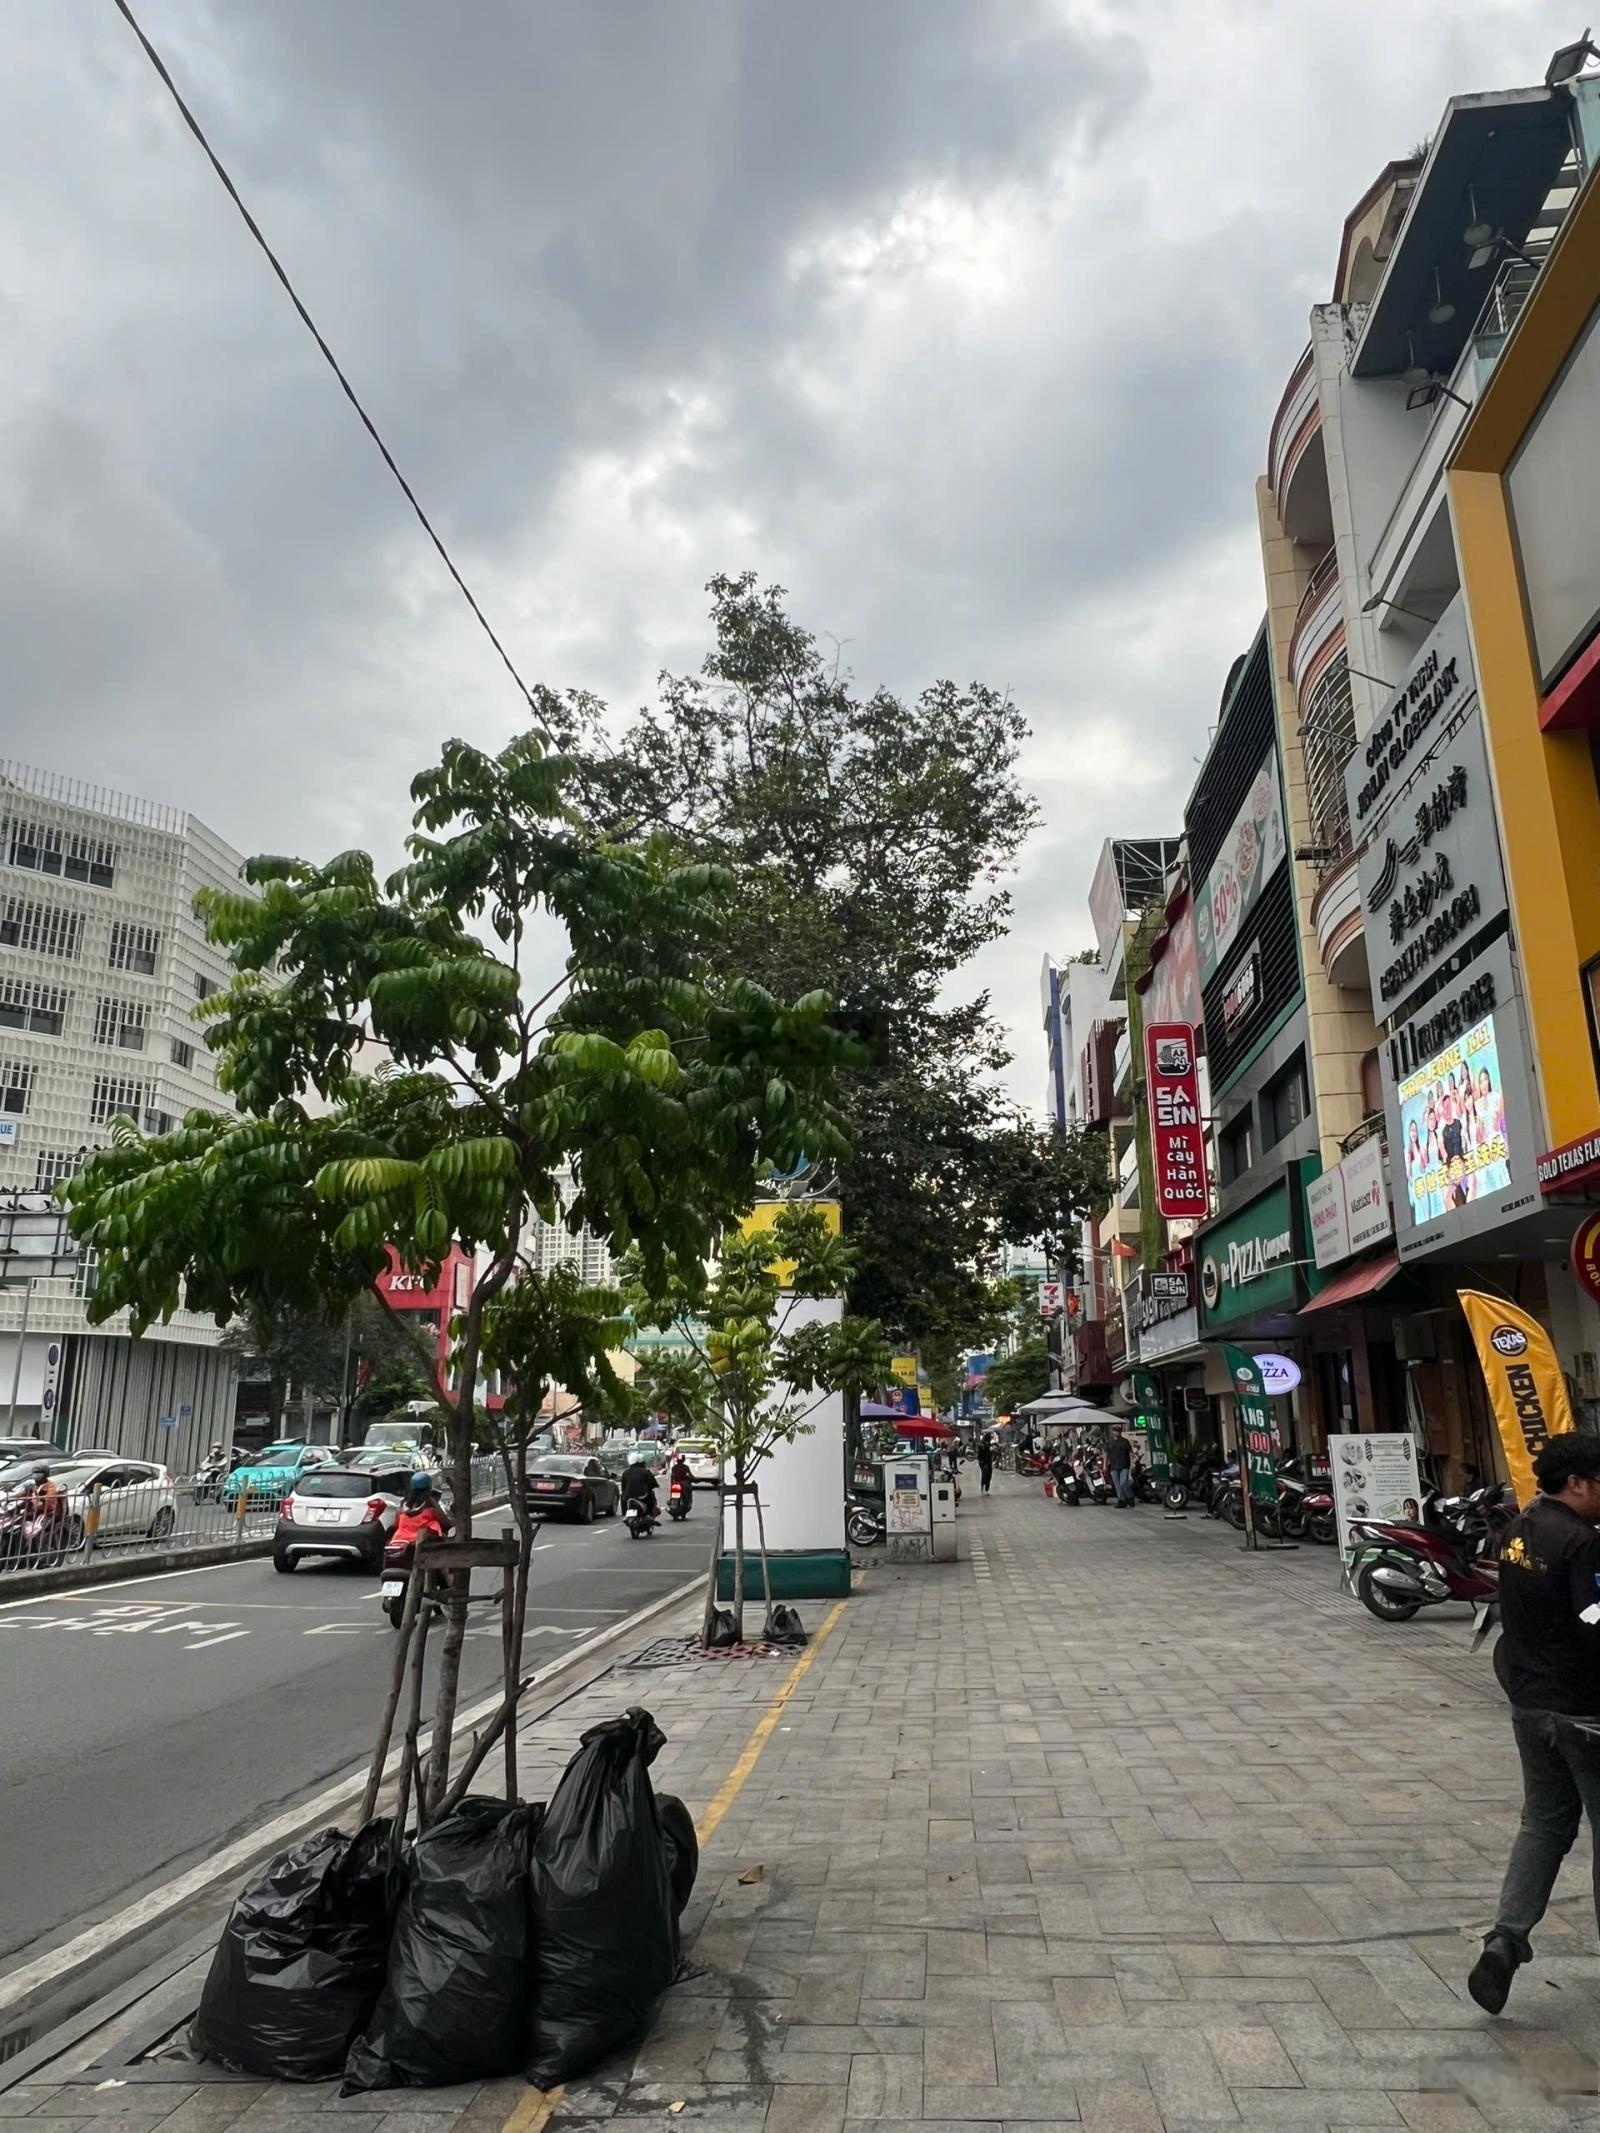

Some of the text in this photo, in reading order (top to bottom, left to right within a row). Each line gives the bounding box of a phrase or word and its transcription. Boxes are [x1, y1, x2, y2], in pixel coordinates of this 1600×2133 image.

[1156, 1085, 1191, 1105] SA
[1158, 1106, 1197, 1127] SIN
[1169, 1136, 1188, 1149] Mì
[1167, 1151, 1195, 1164] cay
[1538, 1161, 1558, 1182] BOLD
[1558, 1145, 1585, 1174] TEXAS
[1167, 1165, 1197, 1180] Hàn
[1164, 1182, 1204, 1199] Quốc
[1228, 1236, 1265, 1289] PIZZA
[1169, 1277, 1184, 1286] SA
[1169, 1286, 1186, 1295] SIN
[1492, 1332, 1527, 1350] TEXAS
[1505, 1363, 1550, 1457] CHICKEN
